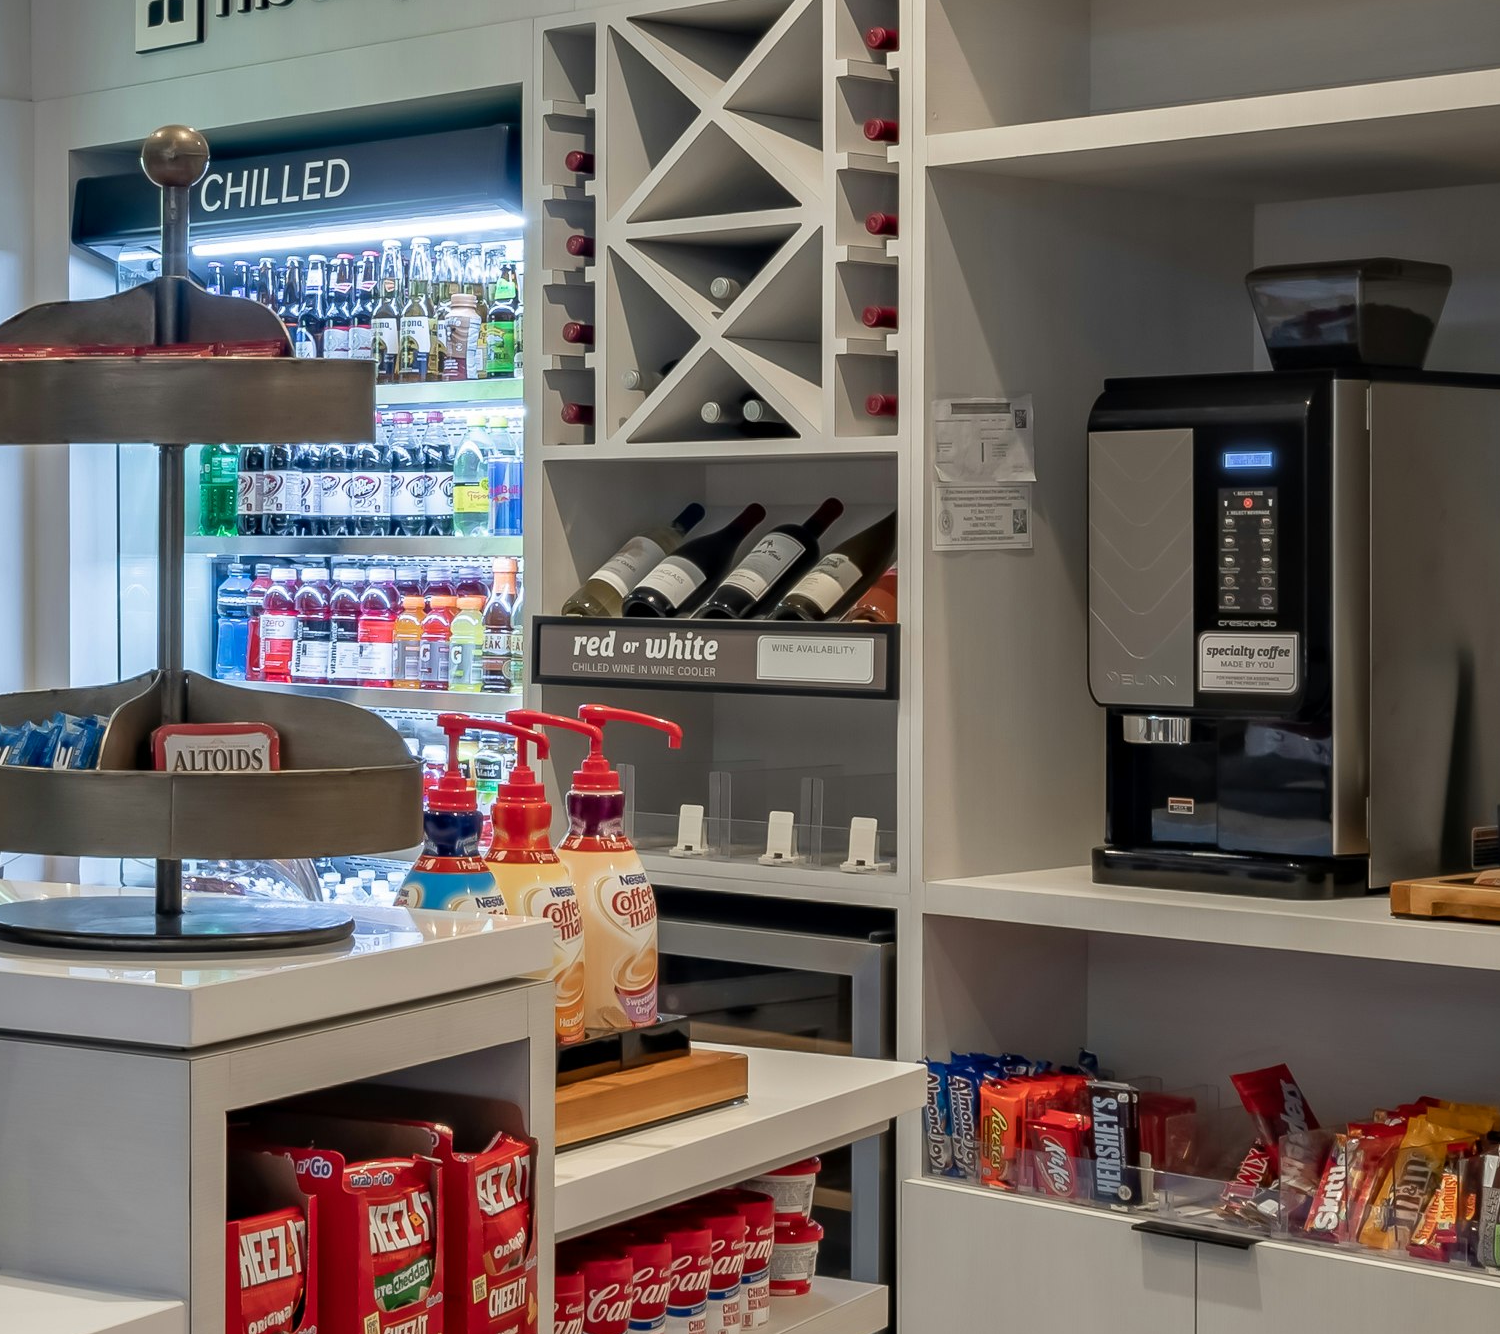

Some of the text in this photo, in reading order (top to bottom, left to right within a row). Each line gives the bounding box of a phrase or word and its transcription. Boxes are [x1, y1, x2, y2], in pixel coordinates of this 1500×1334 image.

[200, 158, 351, 213] CHILLED
[265, 618, 285, 627] zero
[1218, 620, 1277, 628] crescendo
[573, 630, 719, 661] red or white
[771, 643, 794, 654] WINE
[1206, 645, 1290, 661] specialty coffee
[572, 662, 716, 678] CHILLED WINE IN WINE COOLER
[1220, 660, 1243, 668] MADE
[1257, 661, 1275, 669] YOU
[174, 748, 263, 772] ALTOIDS
[612, 886, 653, 915] Coffee
[1092, 1095, 1122, 1196] HERSHEY'S
[1236, 1147, 1269, 1188] WIX
